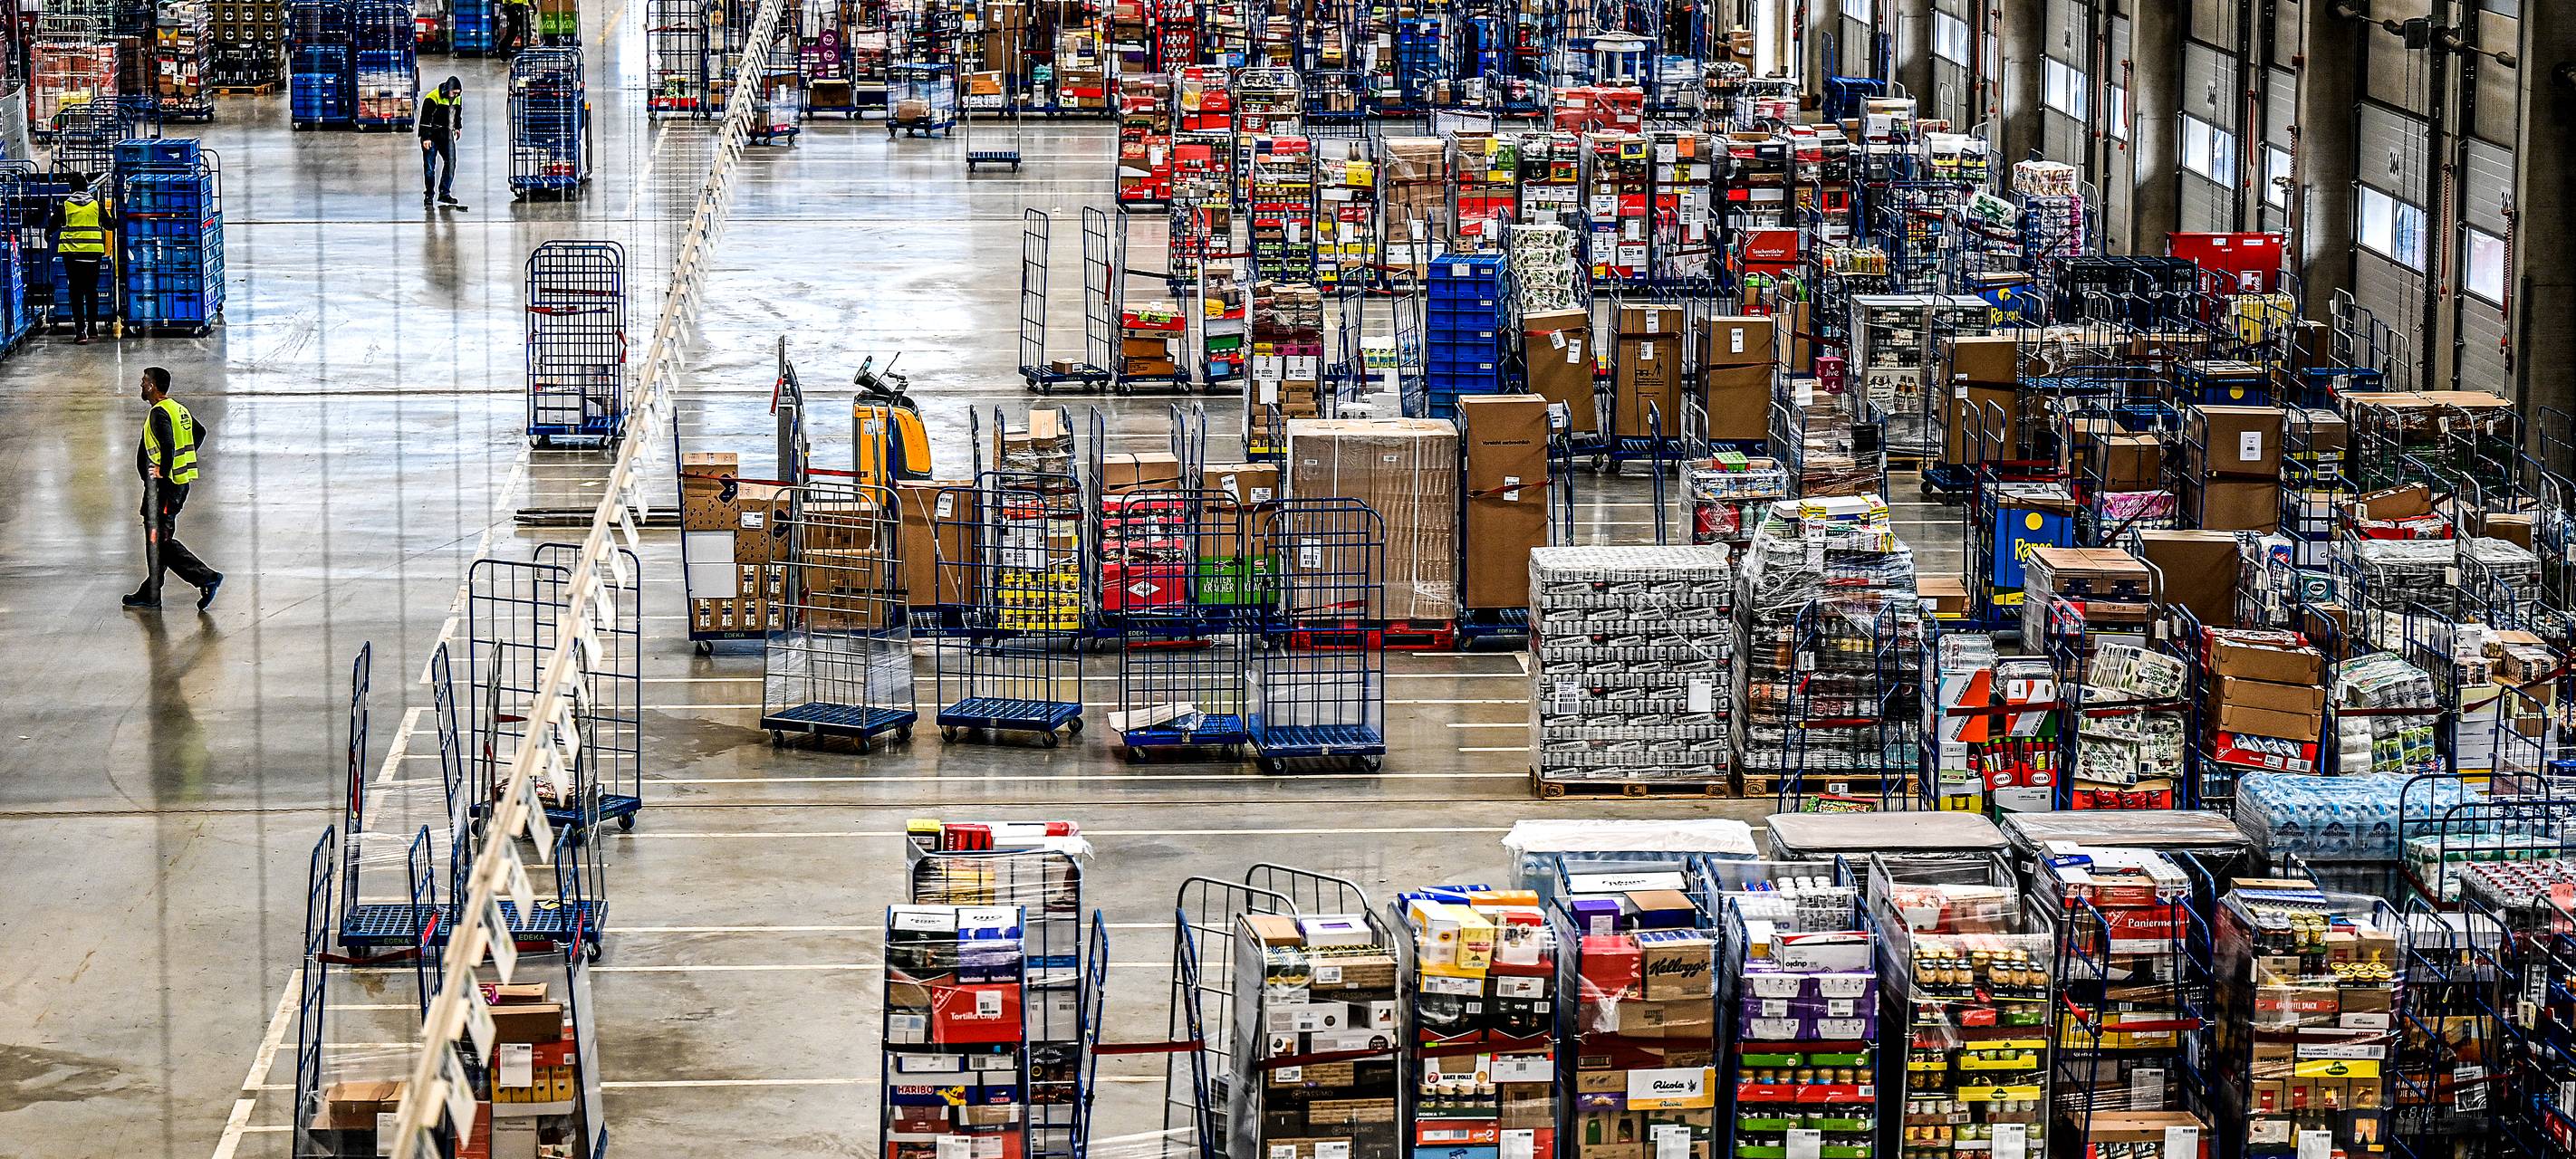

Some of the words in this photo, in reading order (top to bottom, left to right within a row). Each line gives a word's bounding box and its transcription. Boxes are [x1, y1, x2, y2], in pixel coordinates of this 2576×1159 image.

[2389, 152, 2399, 176] 364
[1824, 369, 1840, 378] Jive
[1557, 584, 1585, 593] Krombacher
[1682, 610, 1710, 618] Krombacher
[1556, 637, 1584, 646] Krombacher
[1682, 663, 1710, 671] Krombacher
[1681, 714, 1709, 723] Krombacher
[1556, 742, 1583, 752] Krombacher
[2128, 917, 2181, 927] Paniermel
[1648, 956, 1710, 979] Kellogg's
[951, 1011, 977, 1020] Tortilla
[1652, 1080, 1685, 1090] Ricola
[897, 1085, 935, 1095] HARIBO
